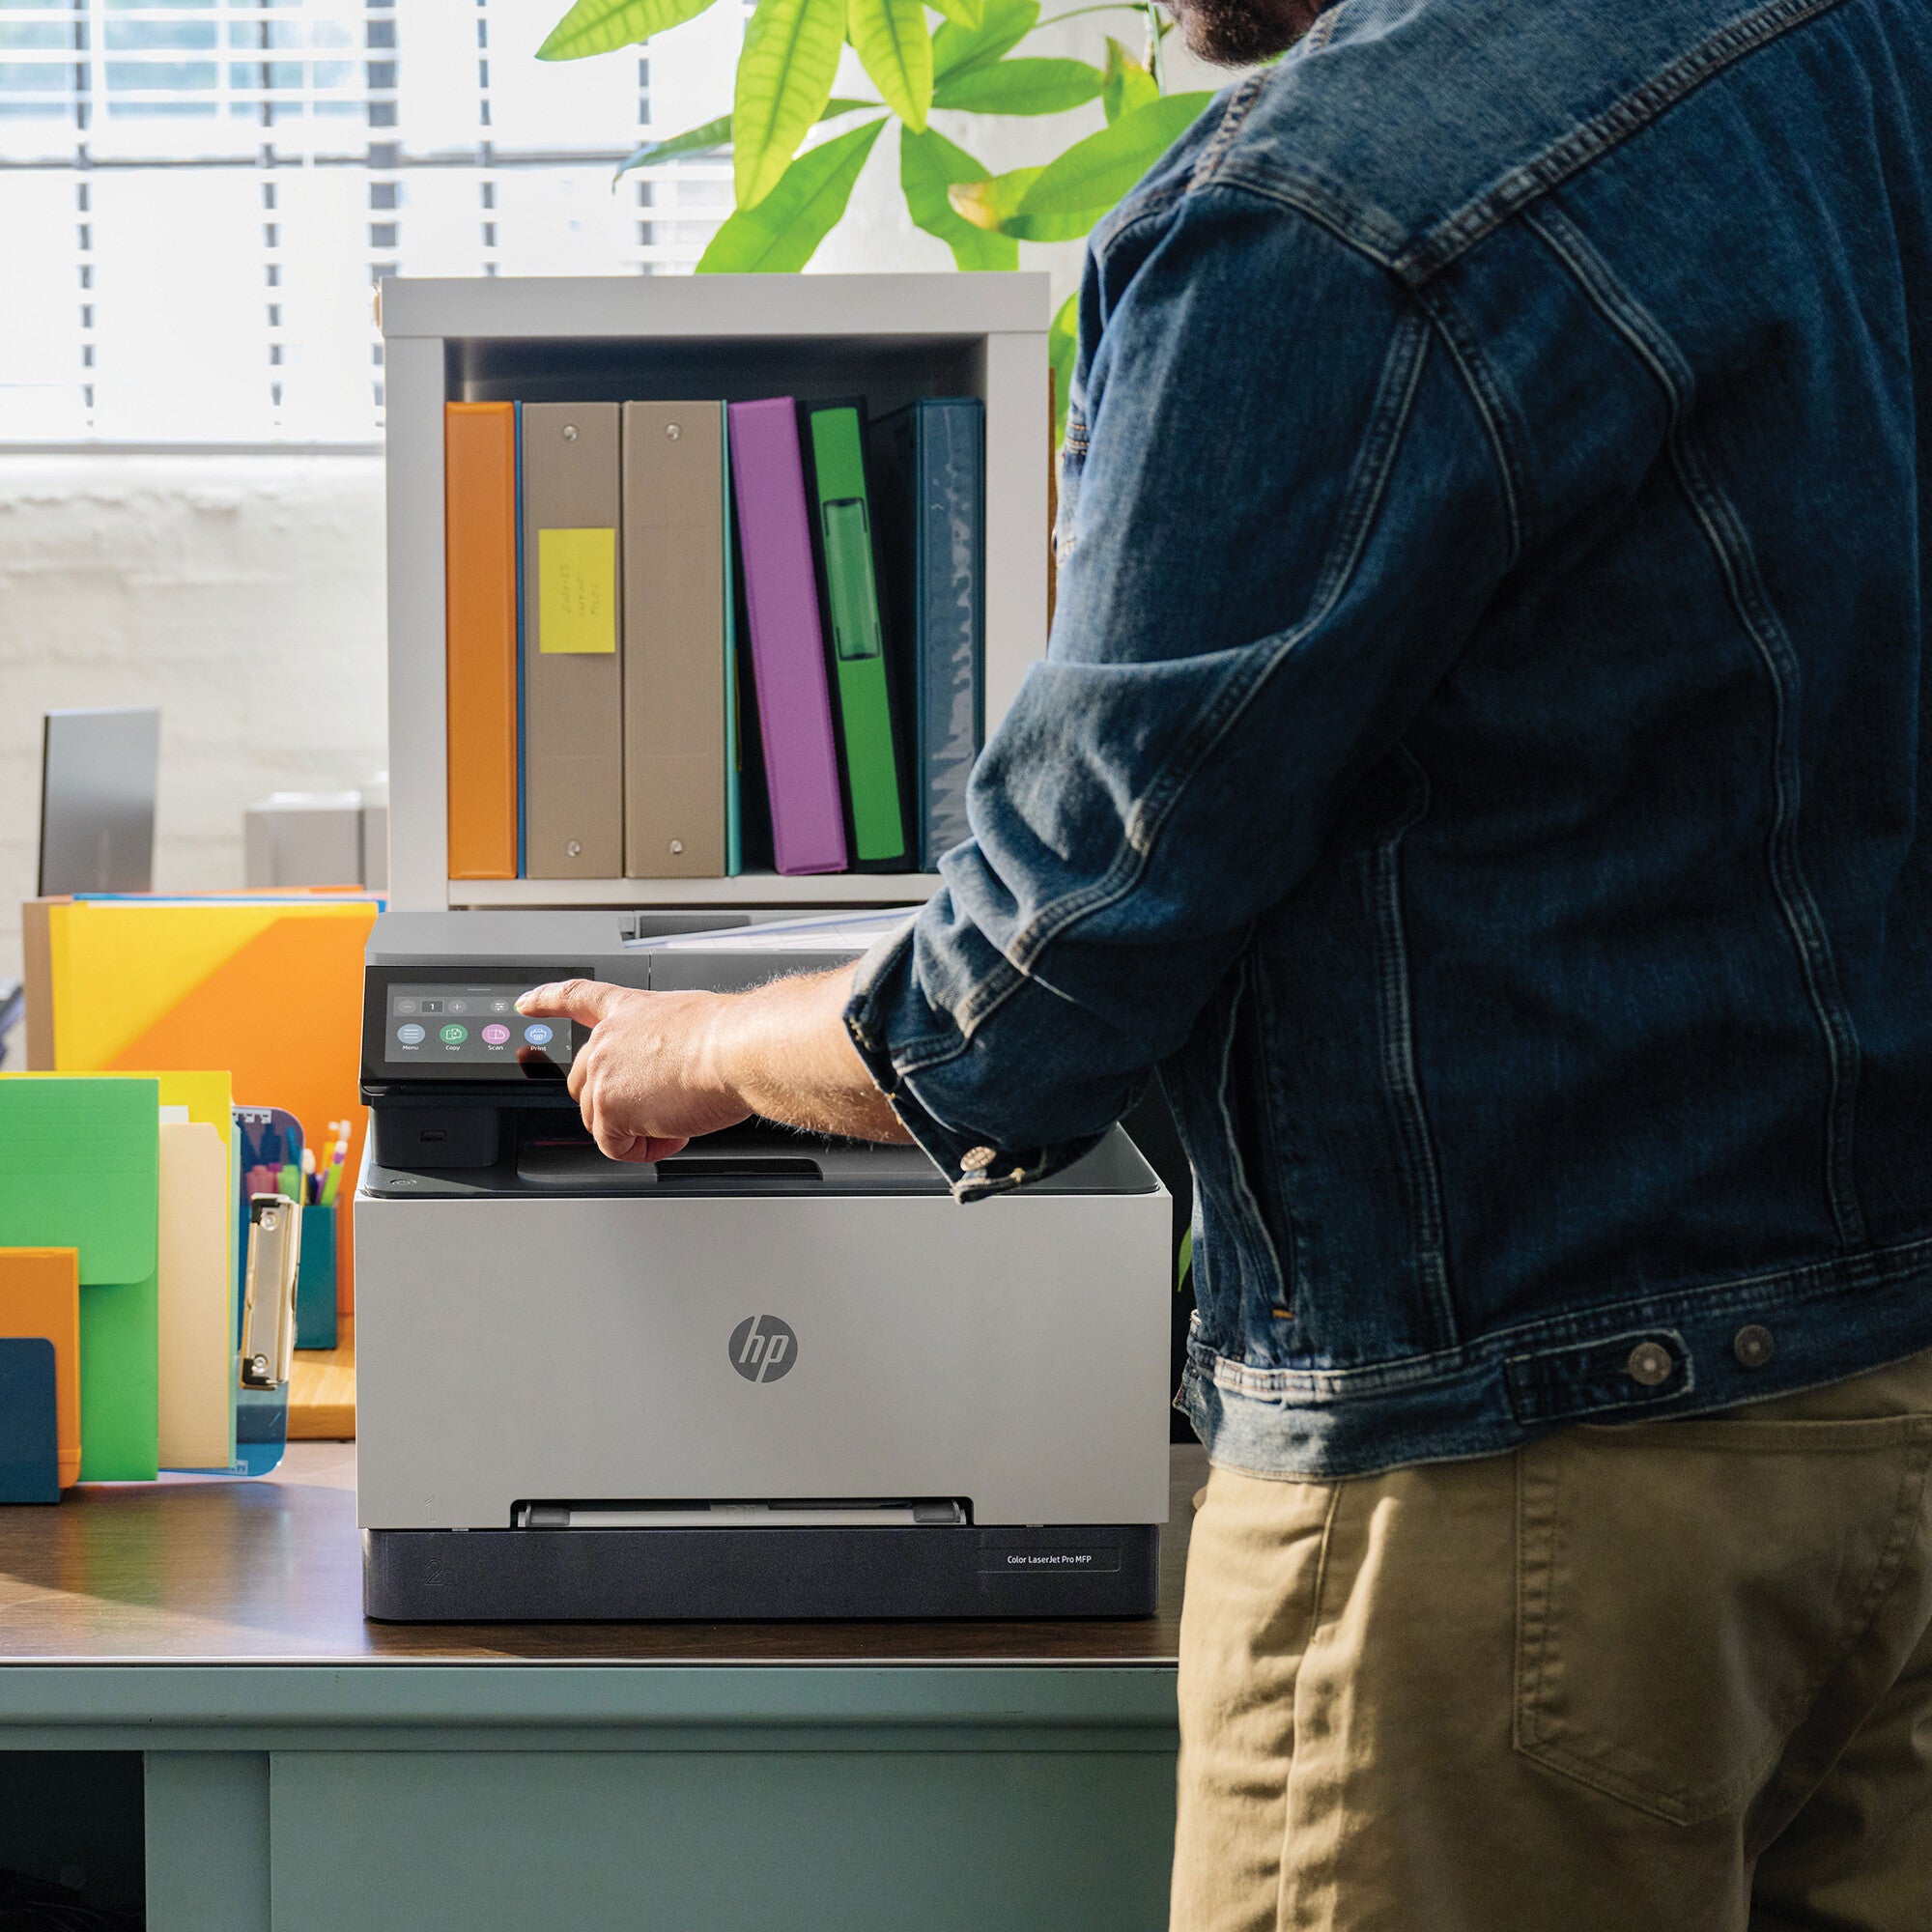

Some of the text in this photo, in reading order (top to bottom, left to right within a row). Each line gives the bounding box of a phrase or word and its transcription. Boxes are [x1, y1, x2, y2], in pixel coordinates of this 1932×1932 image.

[738, 1314, 790, 1383] hp
[423, 1493, 436, 1521] 1
[423, 1557, 444, 1587] 2
[1007, 1555, 1092, 1564] Color LaserJet Pro MFP
